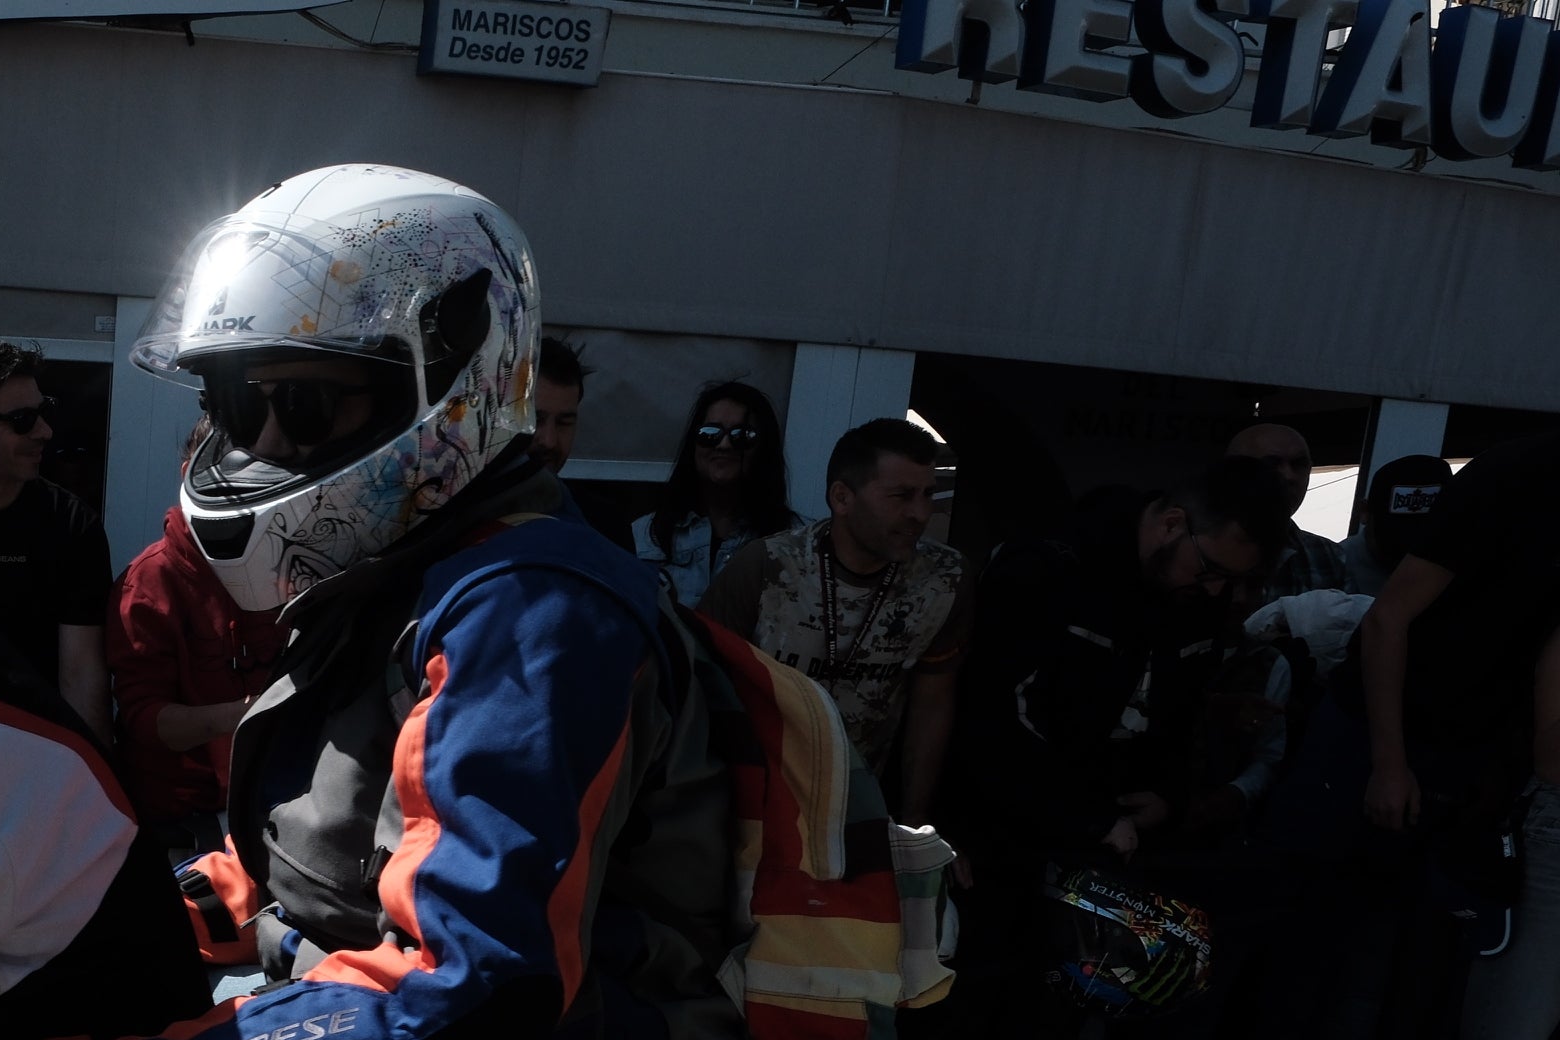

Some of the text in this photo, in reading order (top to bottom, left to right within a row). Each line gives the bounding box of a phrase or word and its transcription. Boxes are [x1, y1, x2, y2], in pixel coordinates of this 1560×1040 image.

[451, 8, 591, 43] MARISCOS
[448, 36, 589, 70] Desde 1952
[1158, 918, 1212, 955] SHARK
